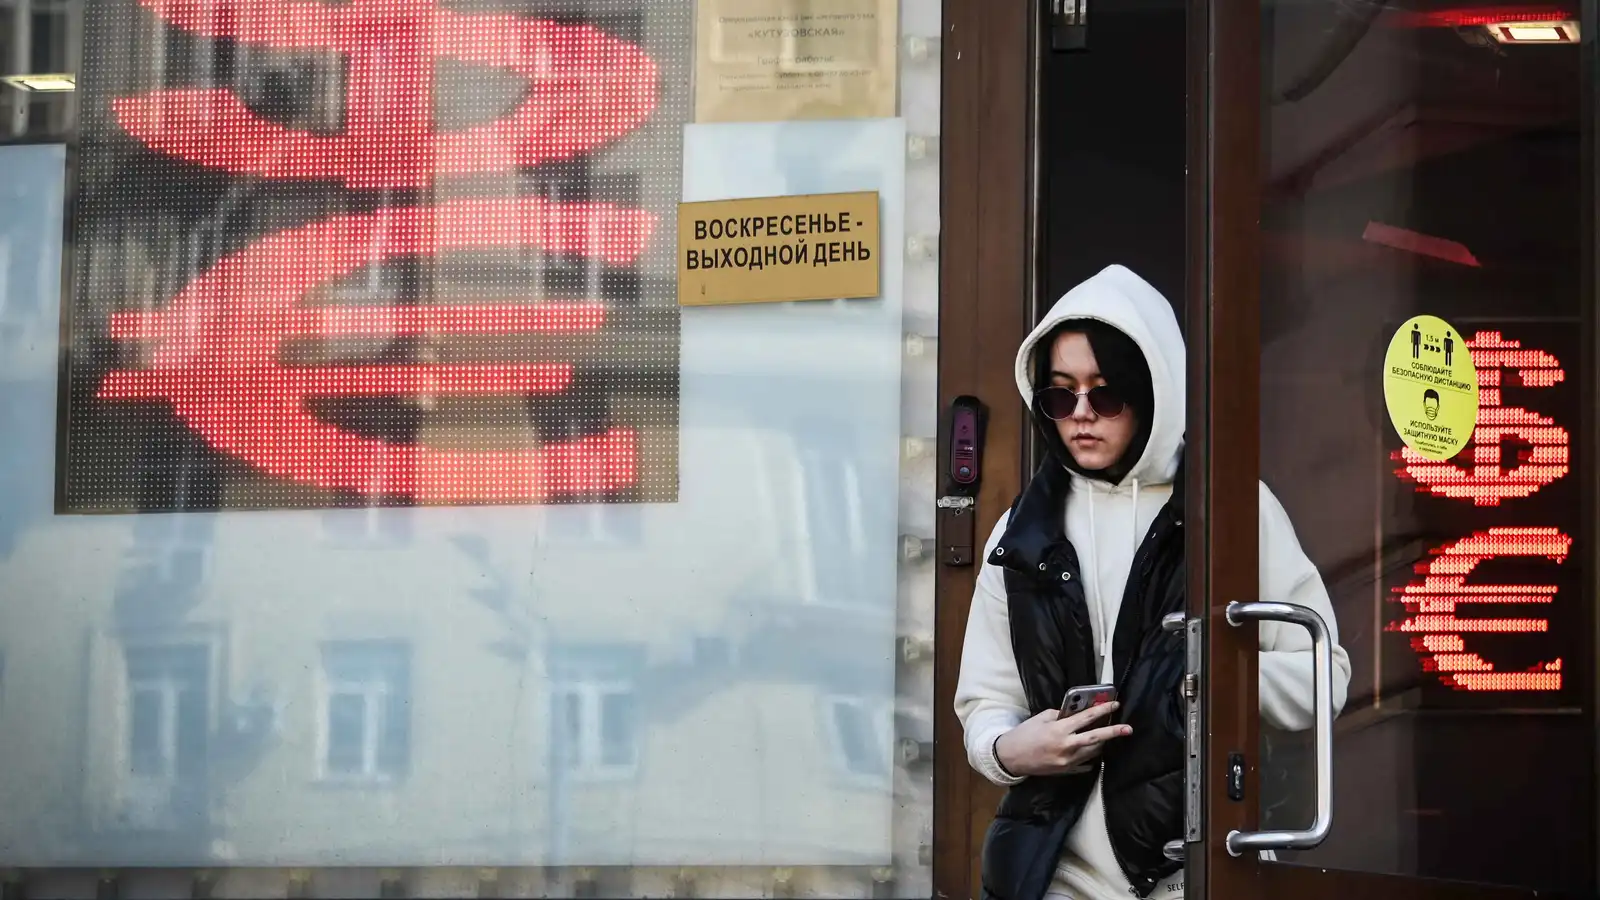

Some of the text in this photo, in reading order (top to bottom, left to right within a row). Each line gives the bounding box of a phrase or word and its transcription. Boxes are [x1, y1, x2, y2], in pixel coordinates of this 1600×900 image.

[694, 212, 851, 240] ВОСКРЕСЕНЬЕ
[686, 238, 871, 270] ВЫХОДНОЙ ДЕНЬ
[1392, 366, 1471, 391] БЕЗОПАСНУЮ ДИСТАНЦИЮ
[1411, 361, 1452, 377] СОБЛЮДАЙТЕ
[1403, 427, 1438, 442] ЗАЩИТНУЮ
[1438, 436, 1459, 446] МАСКУ
[1410, 420, 1452, 435] ИСПОЛЬЗУЙТЕ
